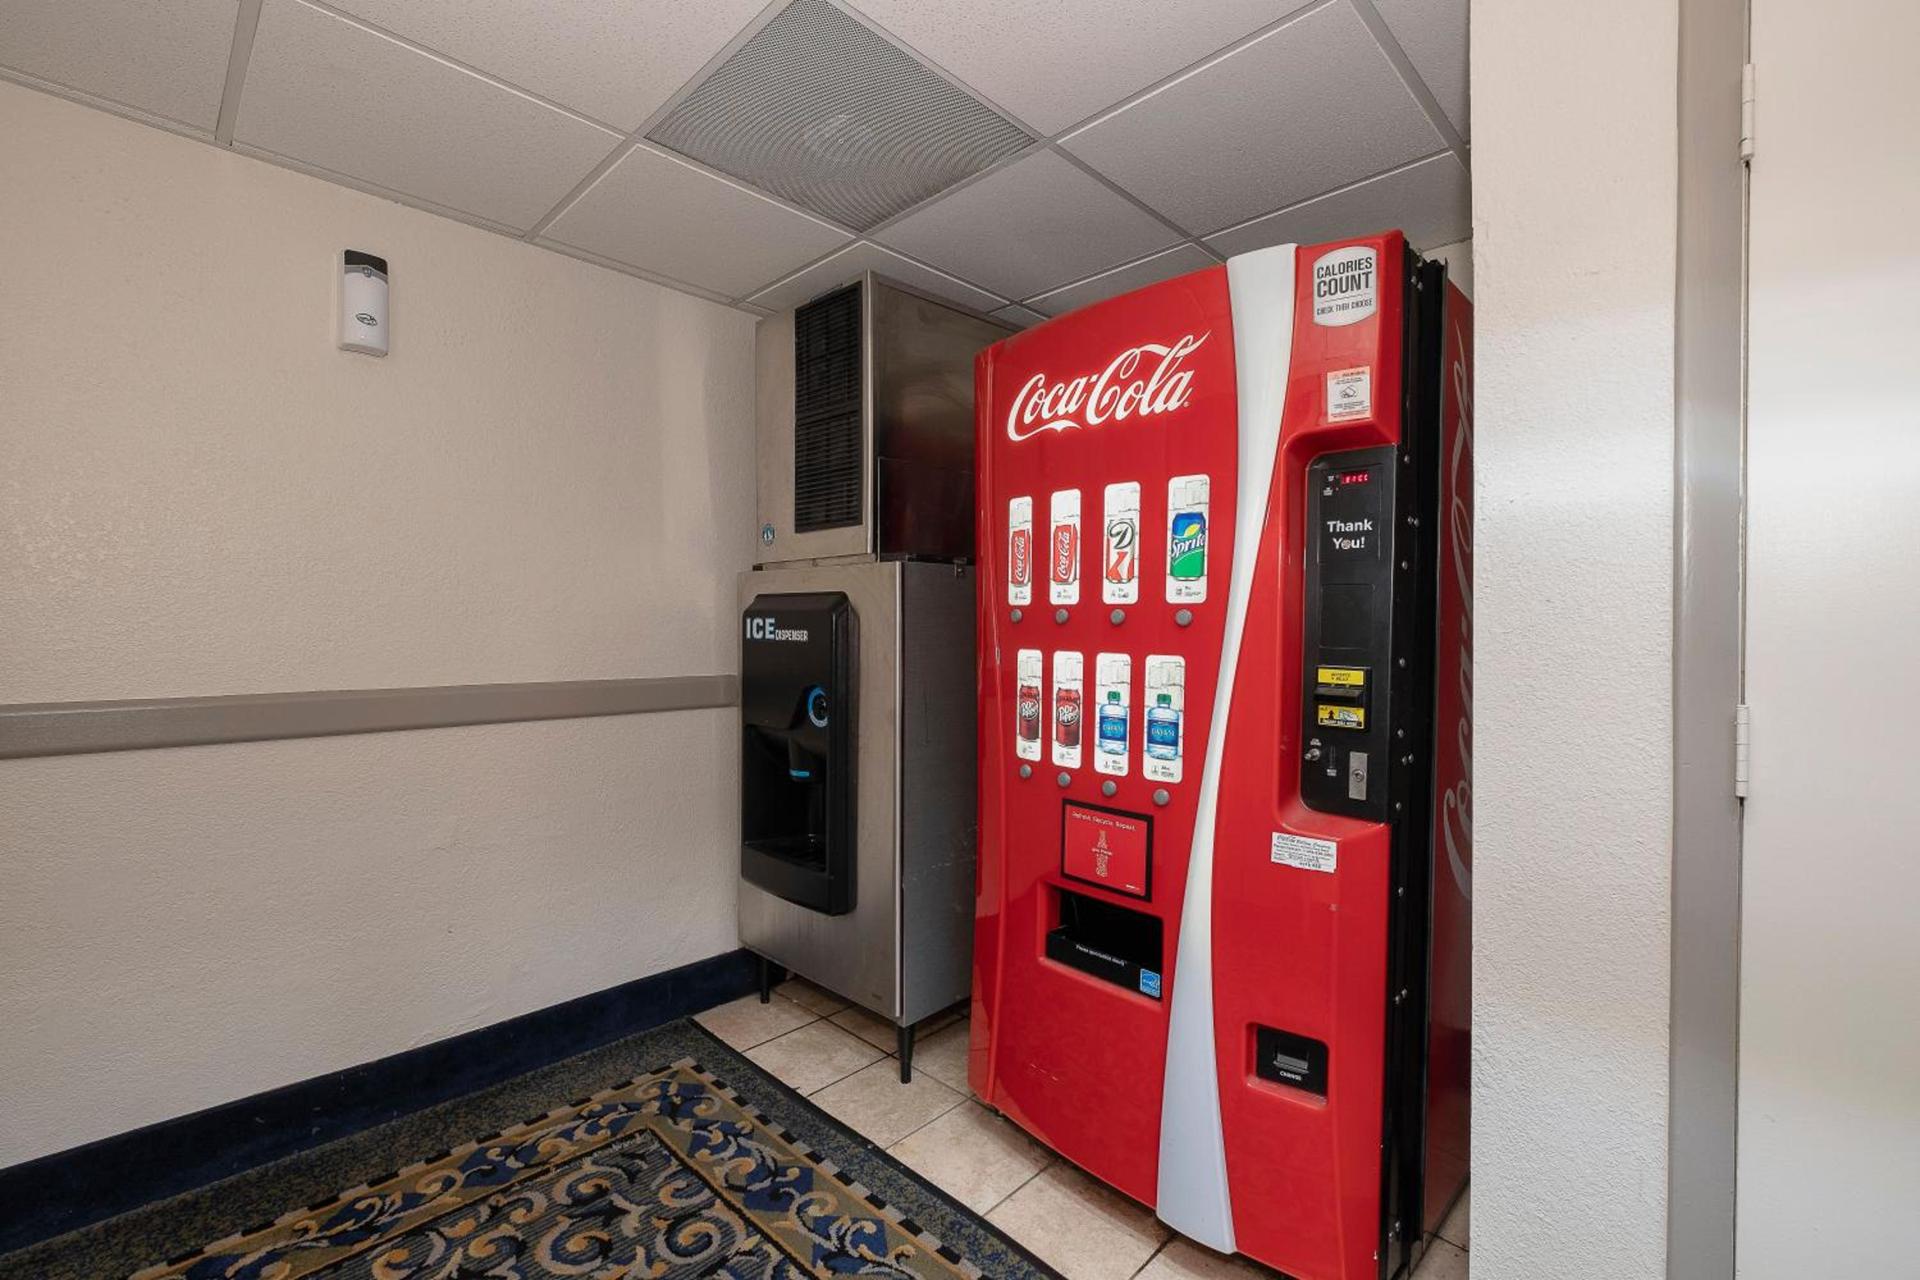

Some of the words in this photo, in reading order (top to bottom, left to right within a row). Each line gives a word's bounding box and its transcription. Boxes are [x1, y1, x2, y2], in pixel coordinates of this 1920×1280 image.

[1317, 257, 1372, 279] CALORIES
[1317, 271, 1372, 298] COUNT
[1007, 330, 1211, 442] Coca-Cola
[1327, 518, 1373, 532] Thank
[1172, 533, 1205, 557] Sprite
[1332, 536, 1365, 549] You!
[746, 618, 775, 639] ICE
[775, 629, 809, 641] DISPENSER
